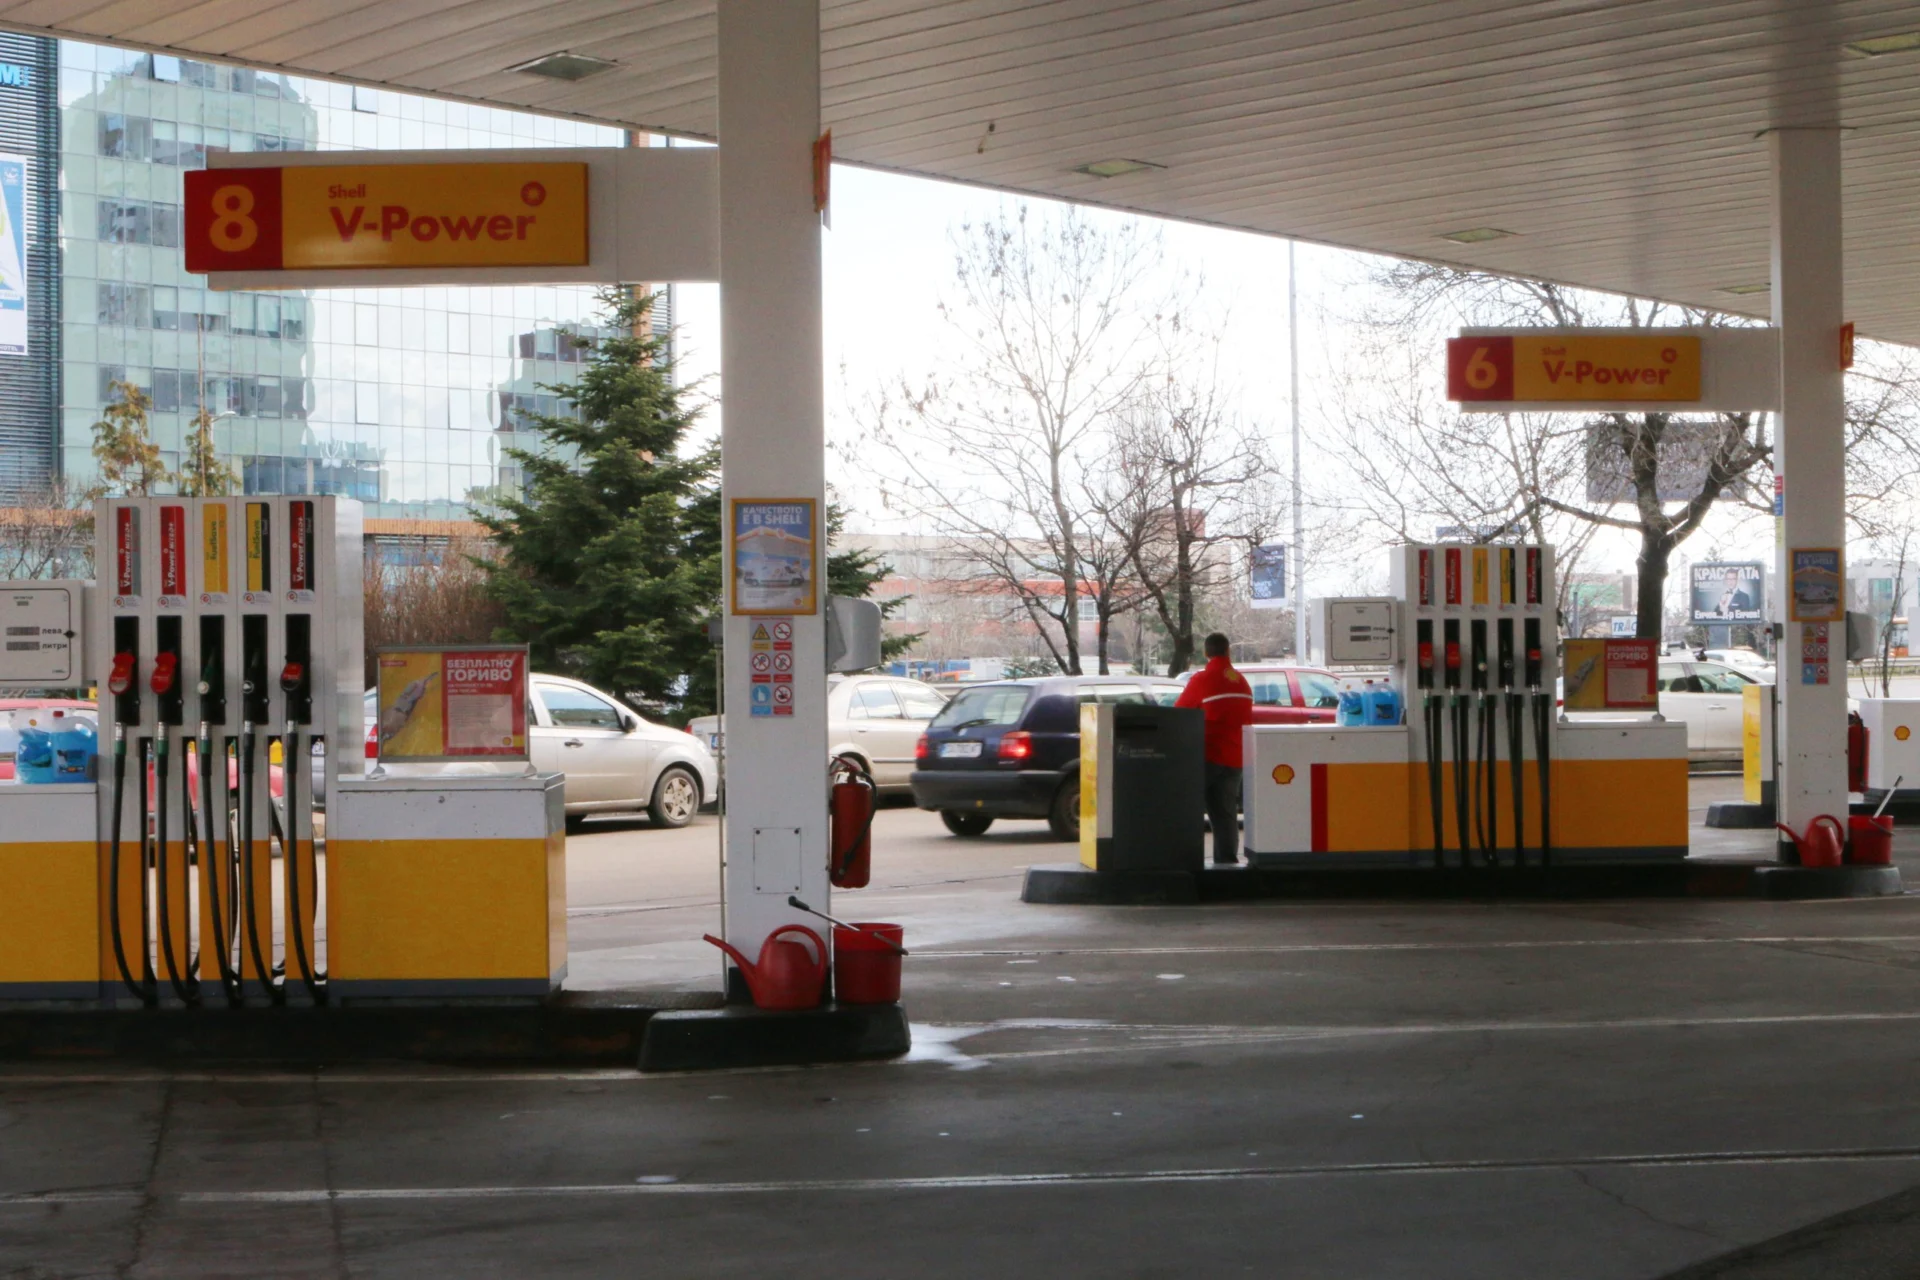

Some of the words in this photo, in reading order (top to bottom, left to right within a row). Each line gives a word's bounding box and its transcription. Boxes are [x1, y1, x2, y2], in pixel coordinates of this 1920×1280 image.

[328, 184, 366, 199] Shell
[209, 184, 258, 252] 8
[329, 205, 537, 244] V-Power
[1542, 346, 1567, 355] Shell
[1465, 347, 1498, 390] 6
[1543, 360, 1671, 385] V-Power
[742, 506, 803, 514] КАЧЕСТВОТО
[765, 514, 803, 525] SHELL
[208, 520, 217, 560] FuelSave
[252, 519, 261, 559] FuelSave
[123, 550, 131, 587] V-Power
[167, 550, 175, 587] V-Power
[296, 544, 304, 582] V-Power
[1694, 566, 1760, 580] КРАСАТА
[446, 659, 514, 668] БЕЗПЛАТНО
[1607, 652, 1648, 660] ГОРИВО
[446, 668, 513, 682] ГОРИВО
